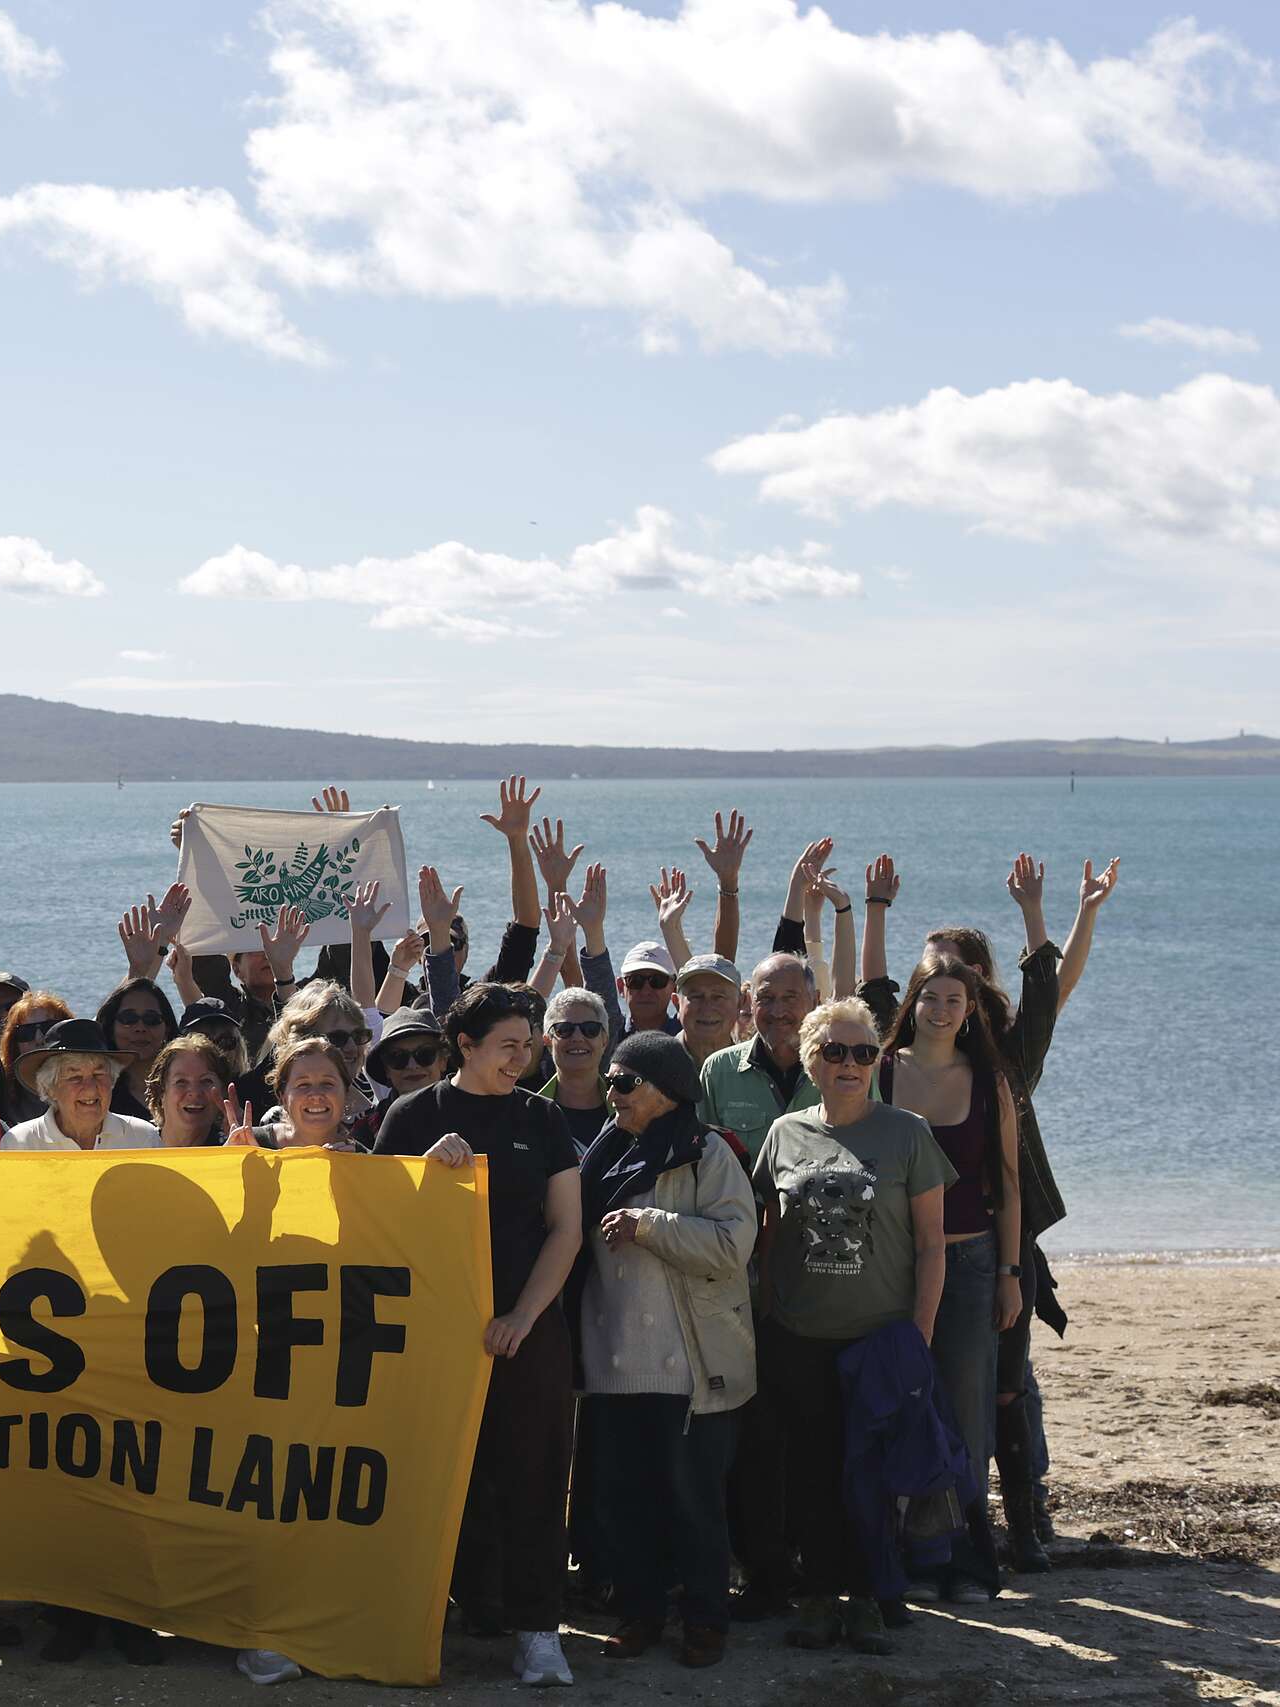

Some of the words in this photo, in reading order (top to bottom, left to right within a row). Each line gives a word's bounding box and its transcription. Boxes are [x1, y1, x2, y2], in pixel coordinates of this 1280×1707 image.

[851, 1168, 878, 1182] ISLAND
[145, 1263, 410, 1407] OFF
[188, 1427, 388, 1526] LAND
